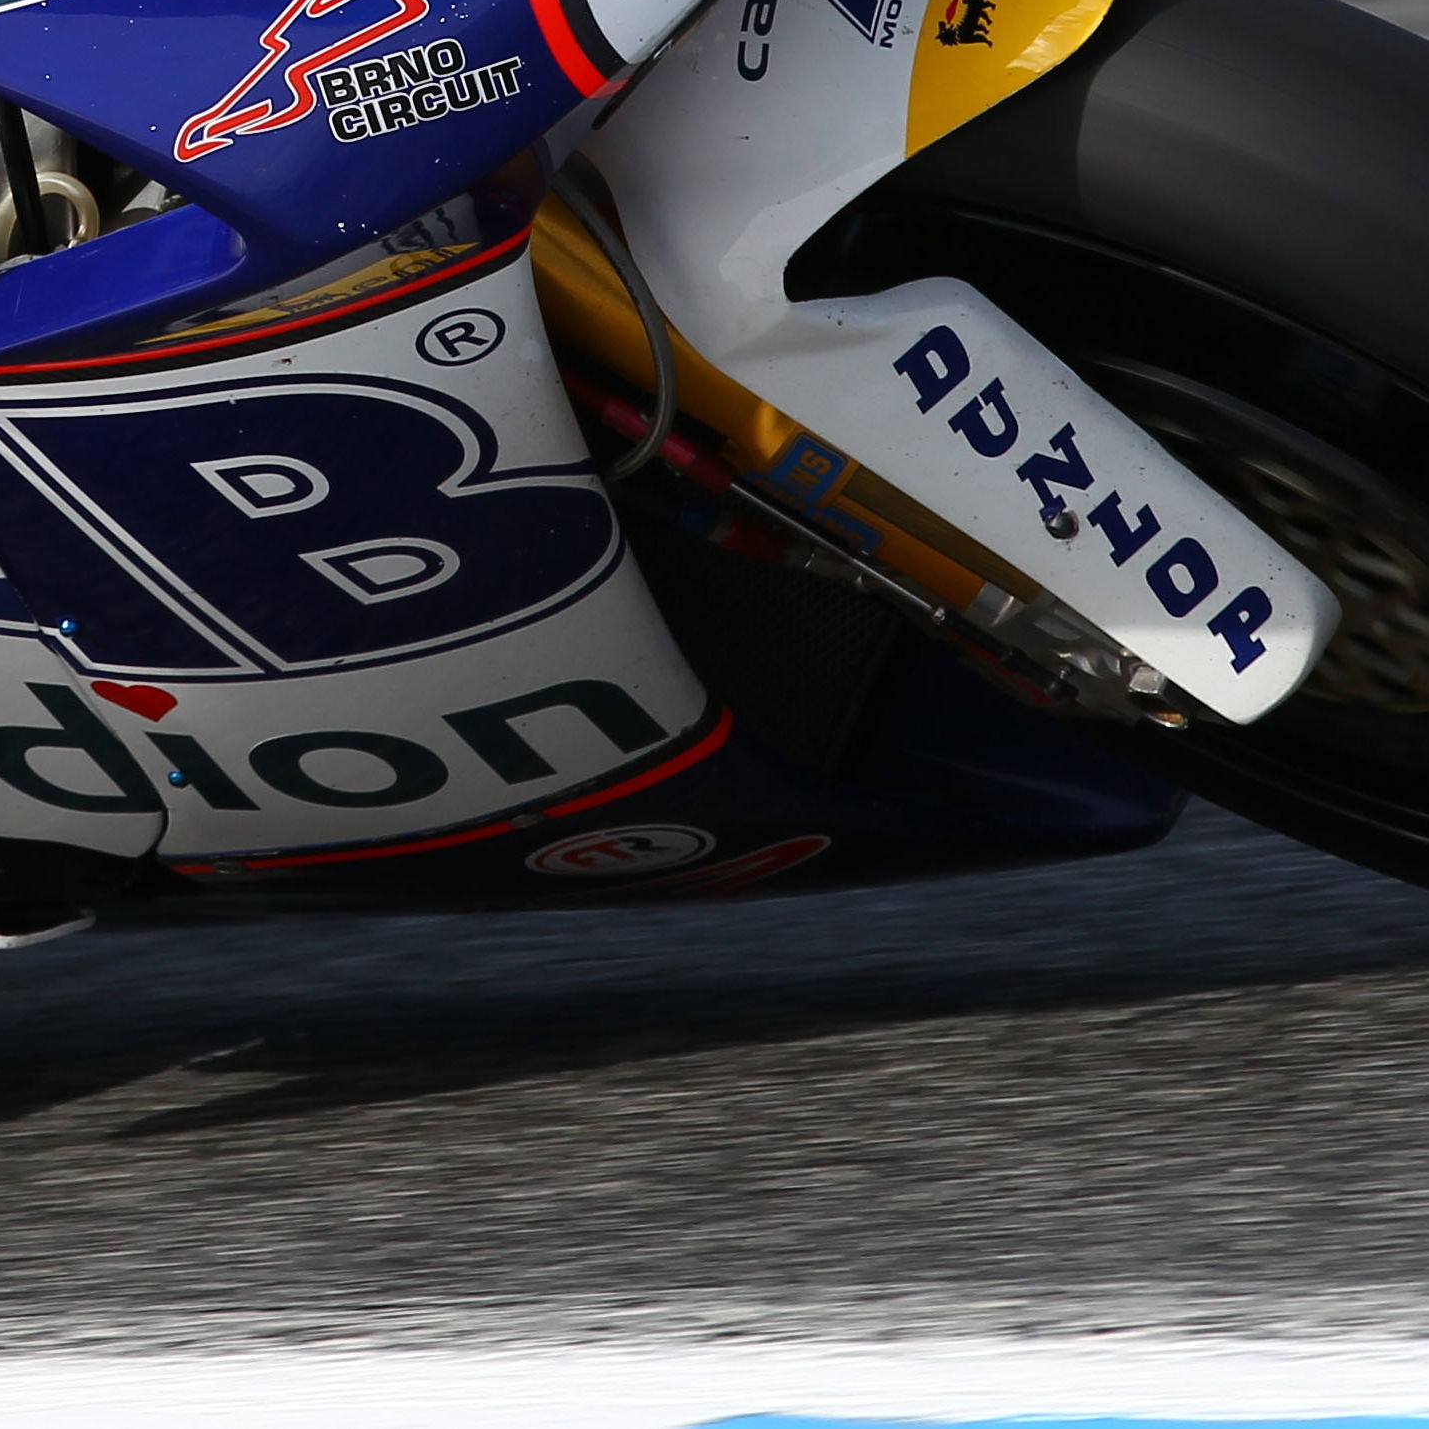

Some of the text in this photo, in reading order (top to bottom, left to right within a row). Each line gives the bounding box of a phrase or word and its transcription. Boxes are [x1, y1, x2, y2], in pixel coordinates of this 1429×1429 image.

[315, 38, 467, 109] BRNO
[328, 56, 525, 144] CIRCUIT
[892, 324, 1274, 675] DUNLOP
